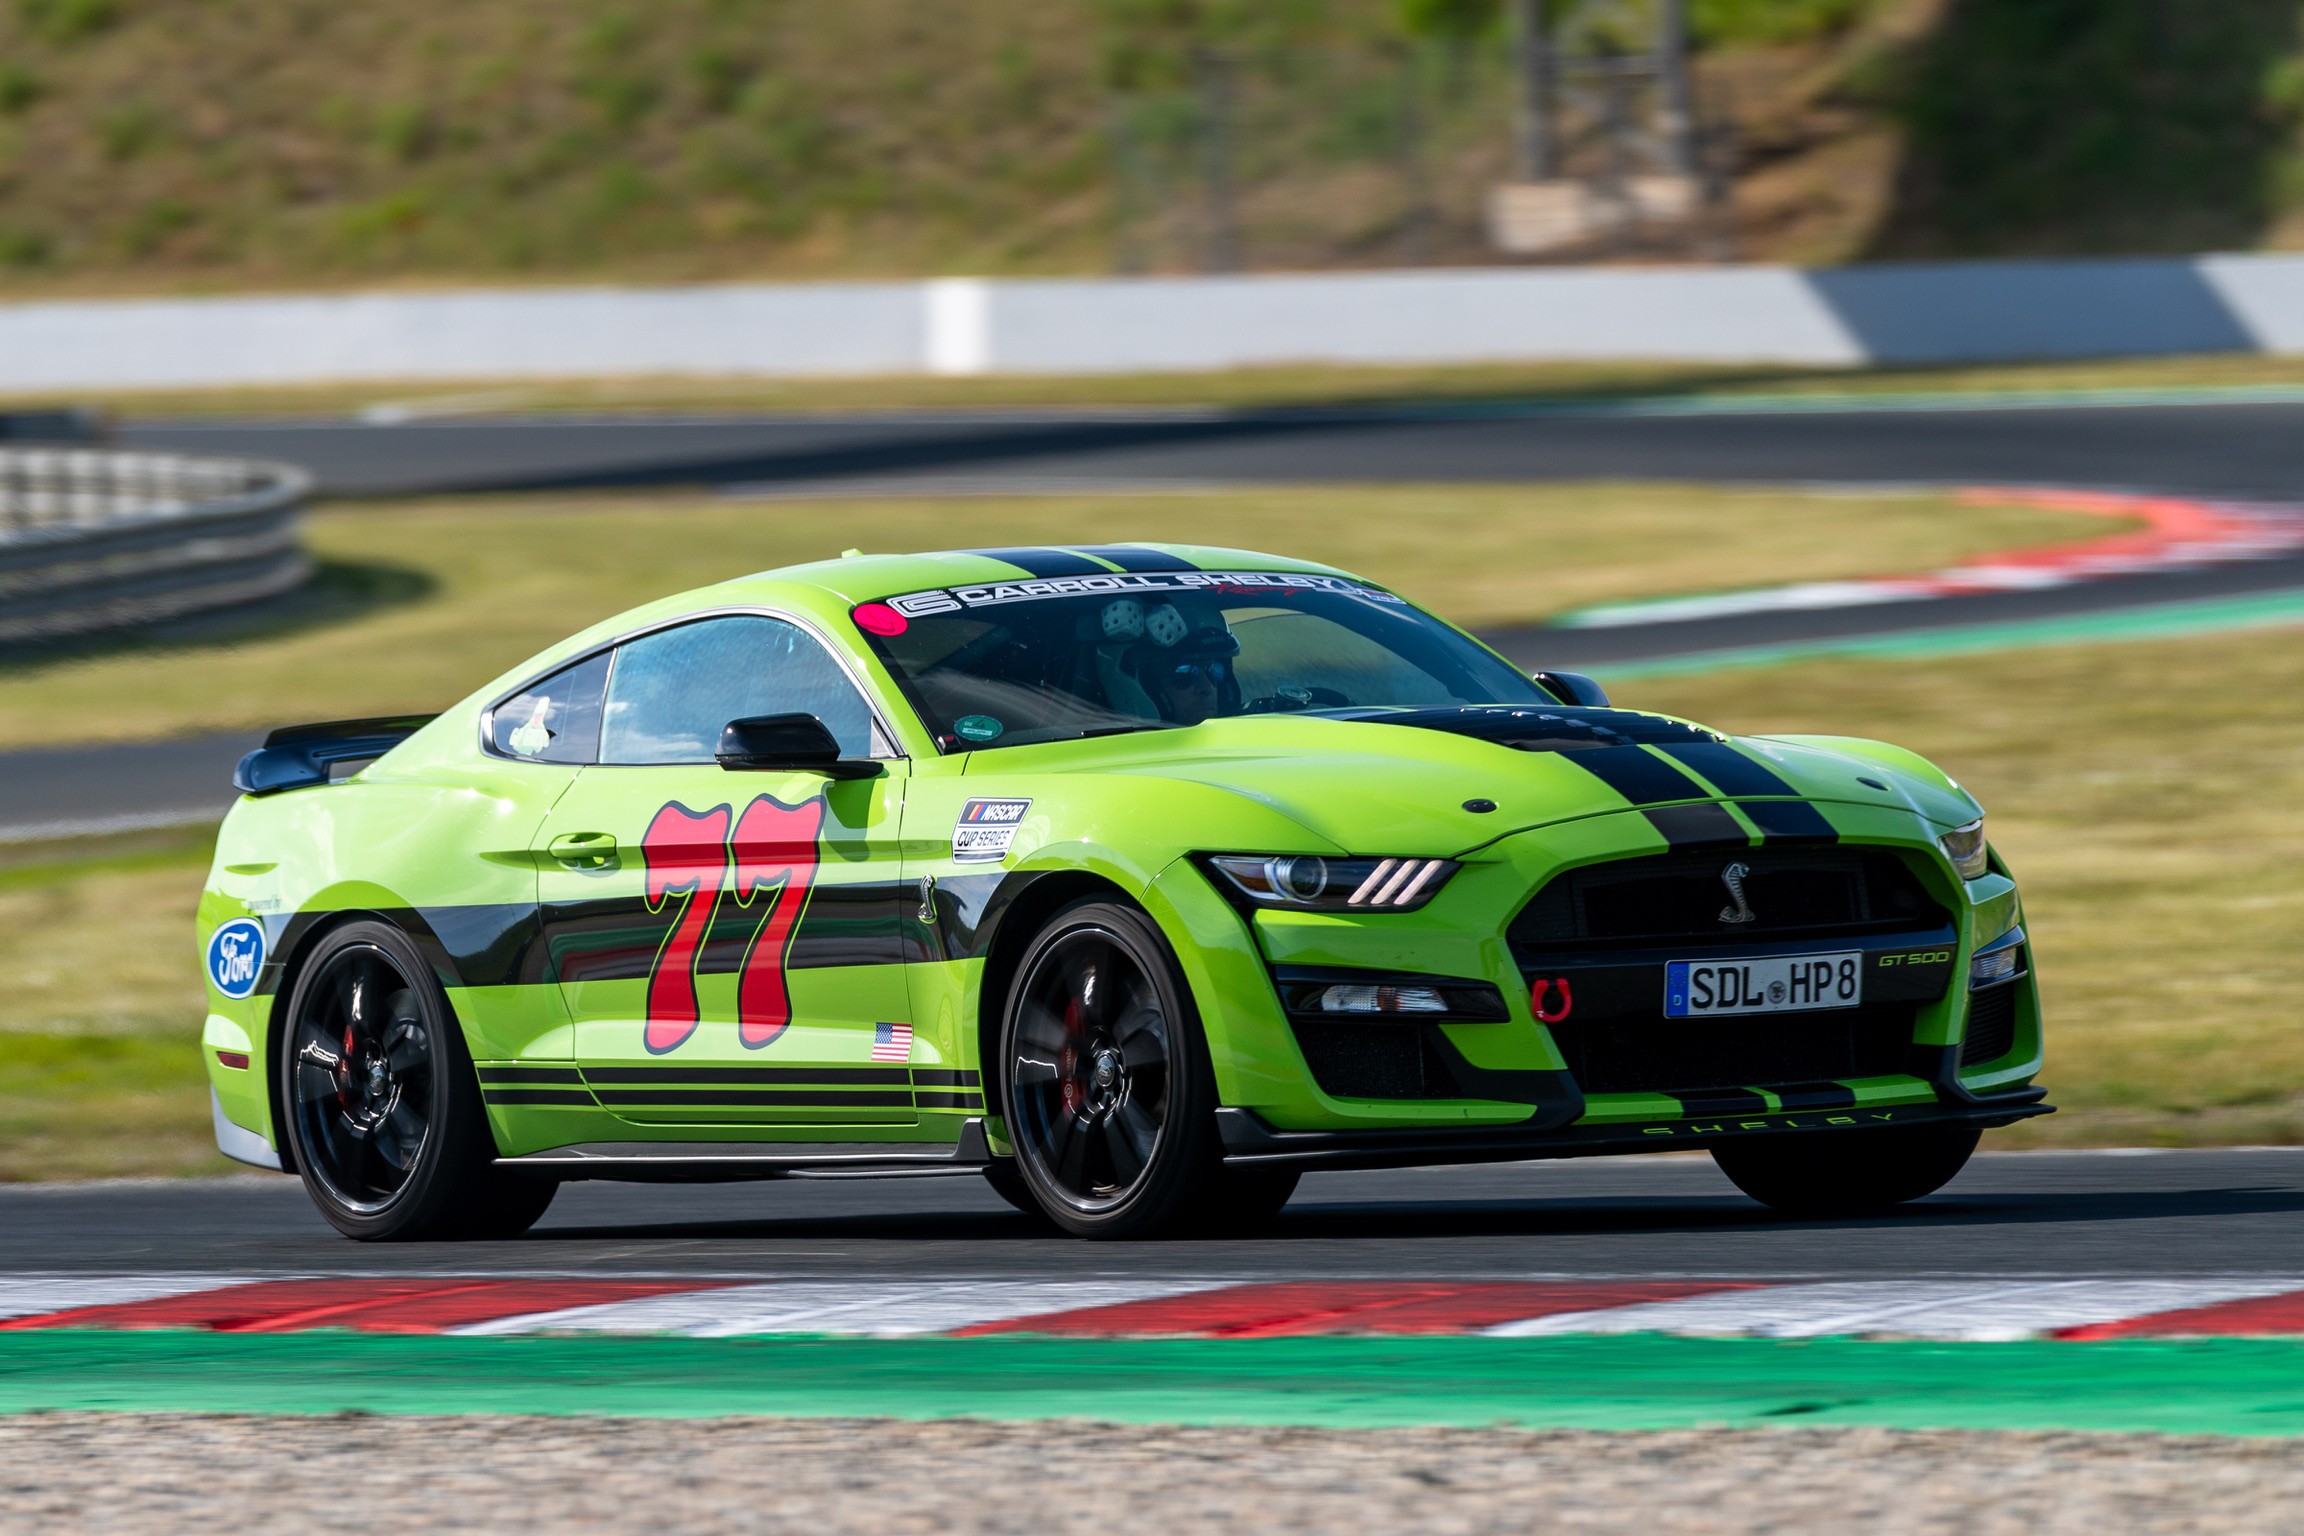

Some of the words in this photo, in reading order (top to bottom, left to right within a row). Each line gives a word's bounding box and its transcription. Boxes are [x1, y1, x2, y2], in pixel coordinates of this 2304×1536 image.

[957, 576, 1169, 602] CARROLL
[1175, 574, 1333, 589] SHELBY
[980, 804, 1025, 821] NASCAR
[957, 830, 979, 847] CUP
[977, 830, 1010, 847] SERIES
[641, 792, 826, 1056] 77
[218, 931, 257, 986] Ford
[1690, 966, 1764, 1009] SDL
[1642, 1112, 1893, 1135] SHELBY
